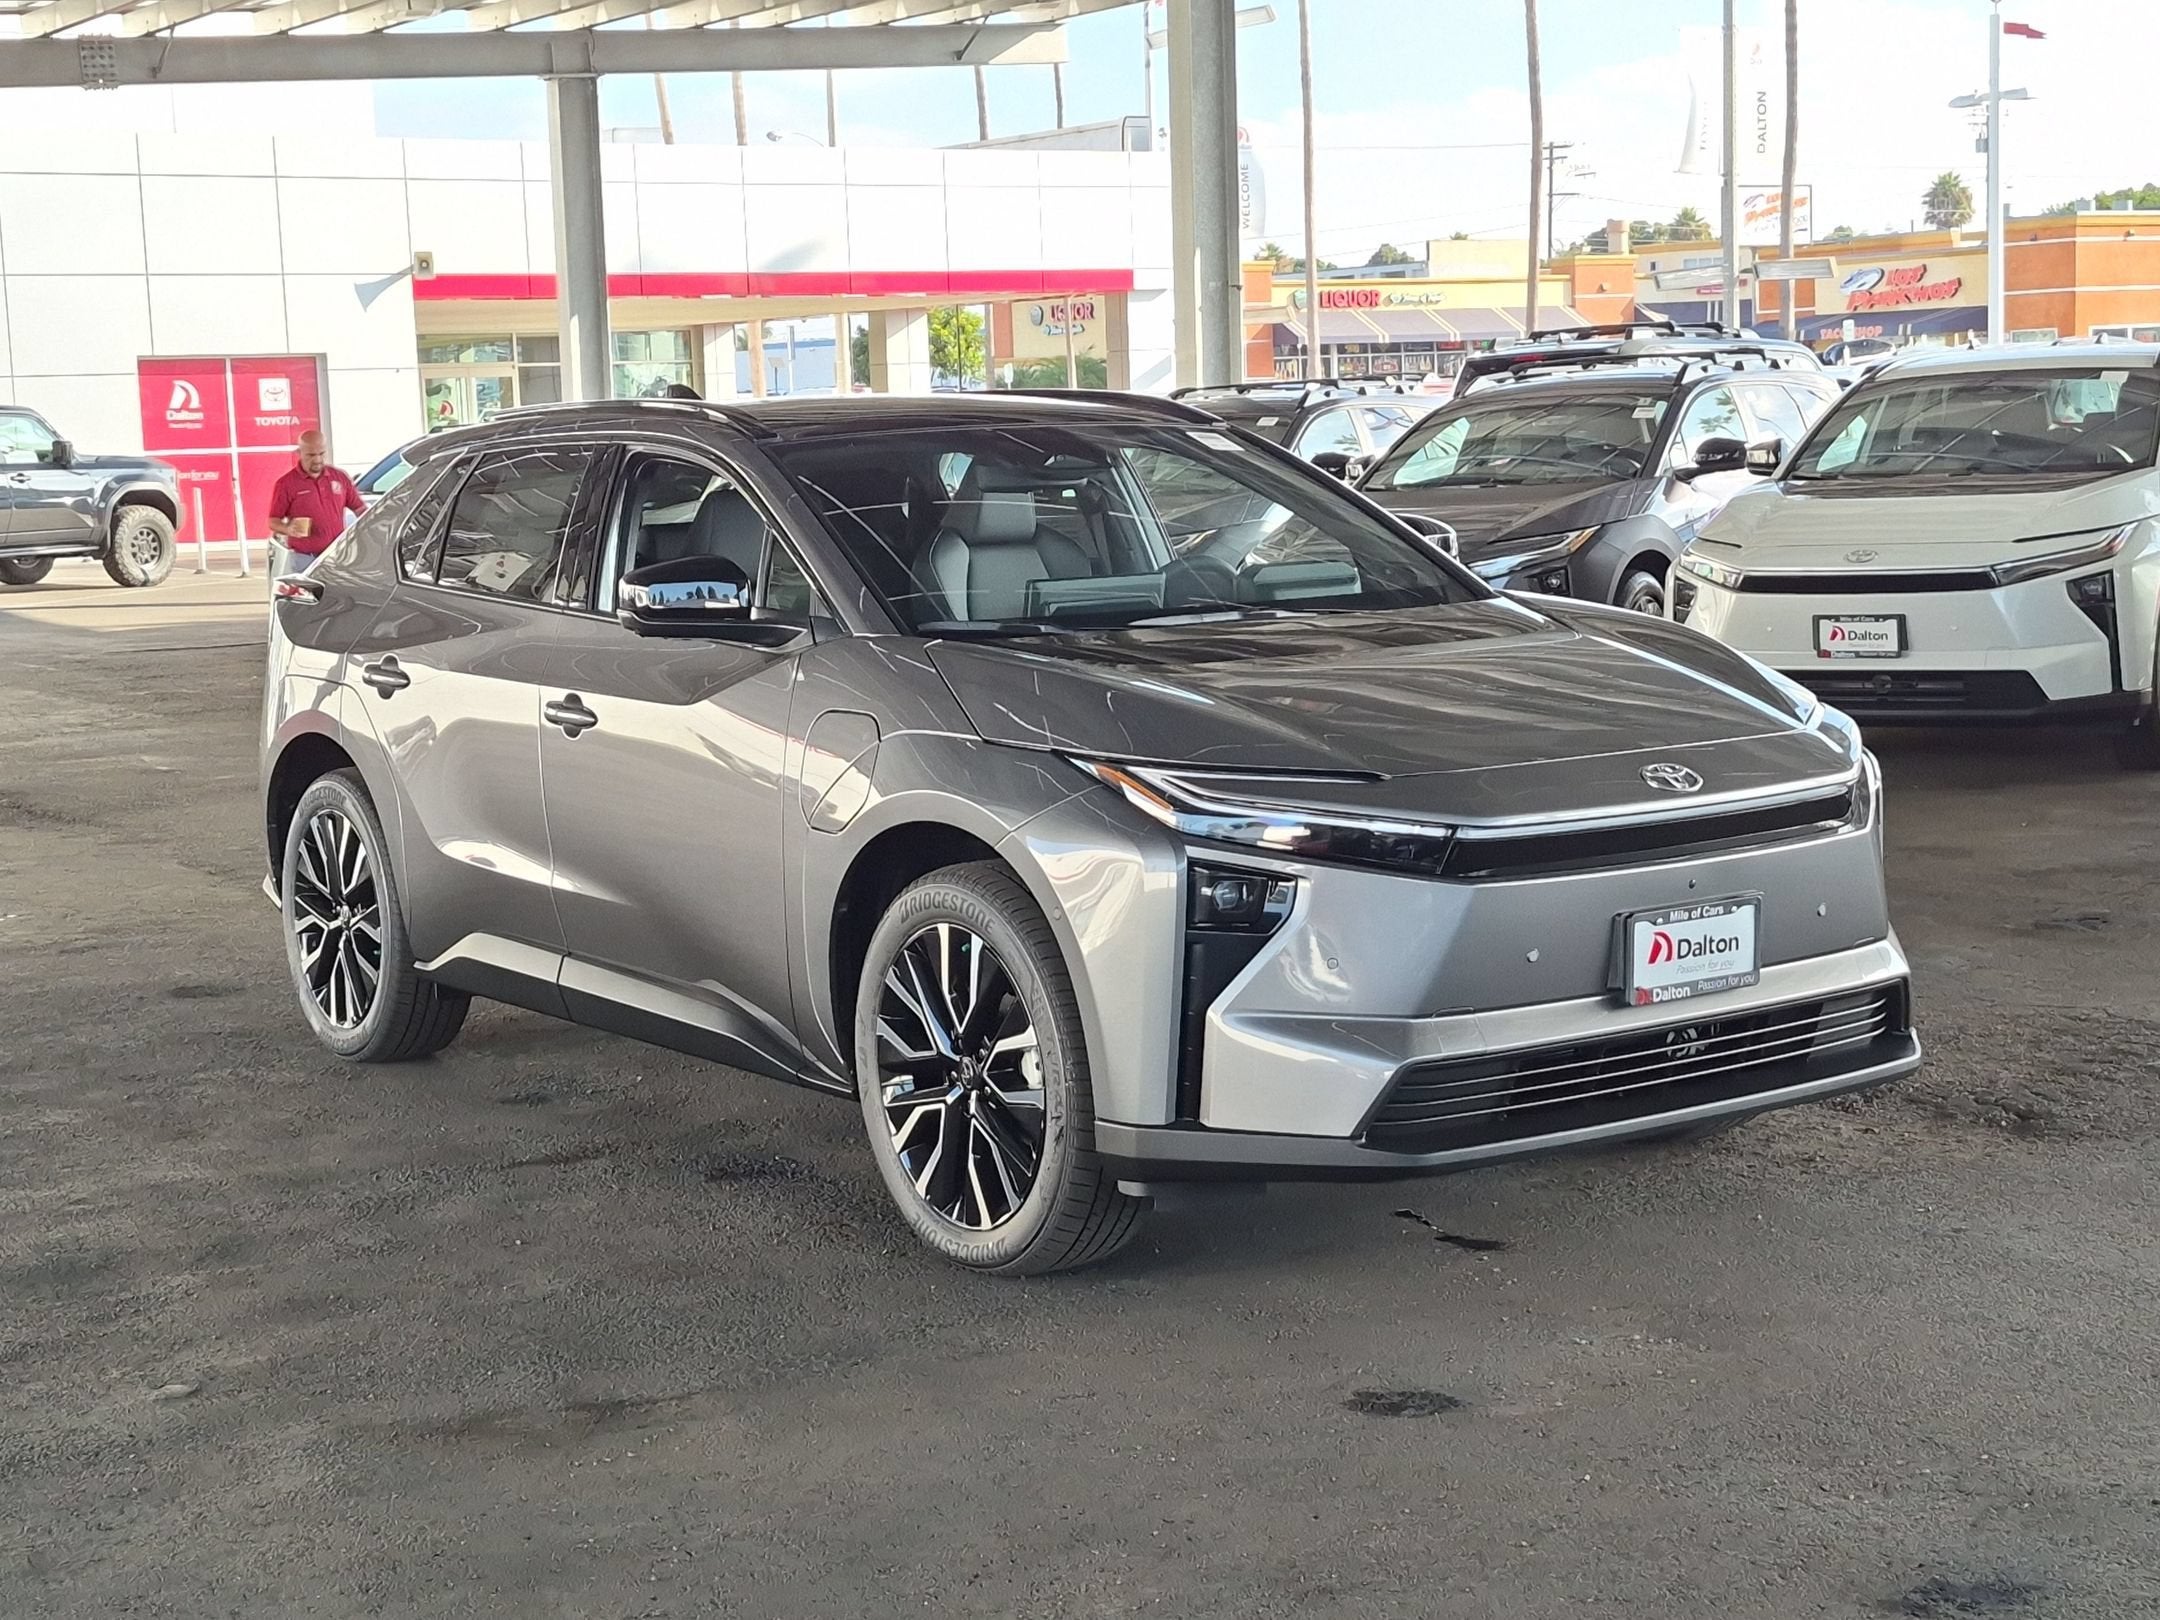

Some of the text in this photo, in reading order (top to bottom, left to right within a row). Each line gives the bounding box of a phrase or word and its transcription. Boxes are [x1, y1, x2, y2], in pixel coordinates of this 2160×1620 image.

[1756, 91, 1767, 154] DALTON
[1240, 163, 1251, 229] WELCOME
[1320, 290, 1381, 309] LIQUOR
[254, 416, 300, 427] TOYOTA
[1847, 629, 1888, 641] Dalton
[899, 890, 996, 936] BRIDGESTONE
[1669, 905, 1724, 922] Mile of Cars
[1677, 934, 1739, 960] Dalton
[1676, 959, 1735, 975] Passion for you
[1652, 973, 1755, 1003] Dalton Passion for you
